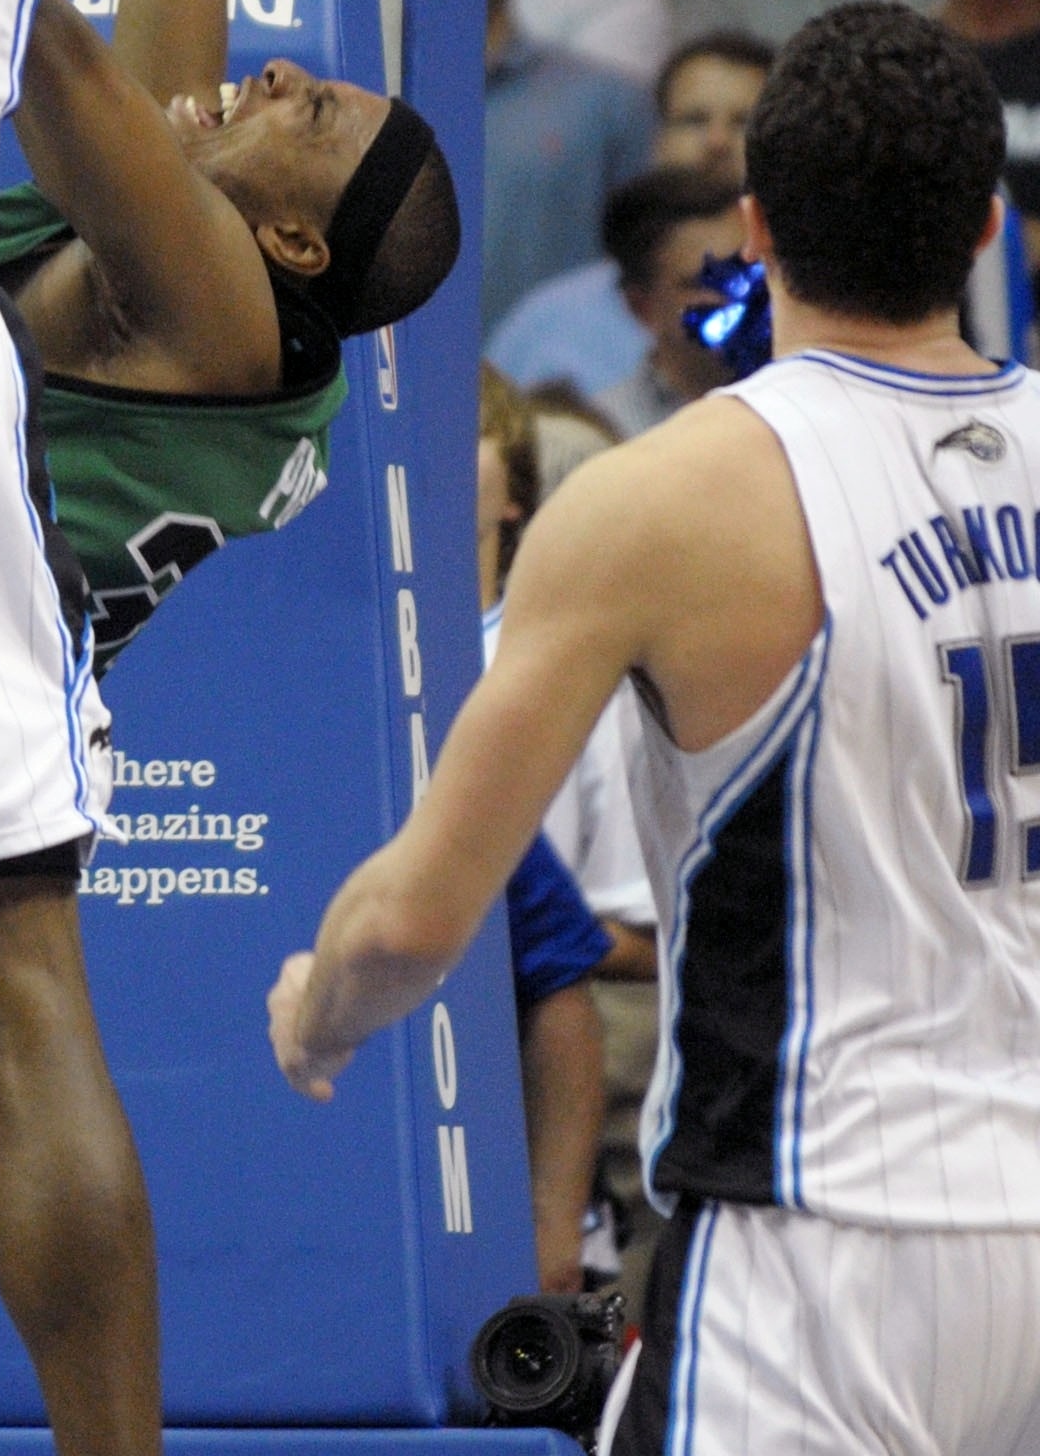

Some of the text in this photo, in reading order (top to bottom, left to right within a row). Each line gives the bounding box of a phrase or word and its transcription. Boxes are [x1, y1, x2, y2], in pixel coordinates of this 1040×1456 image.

[880, 504, 1040, 620] TURKO
[112, 751, 216, 787] here
[97, 804, 269, 851] mazing
[387, 465, 473, 1233] NBAOM
